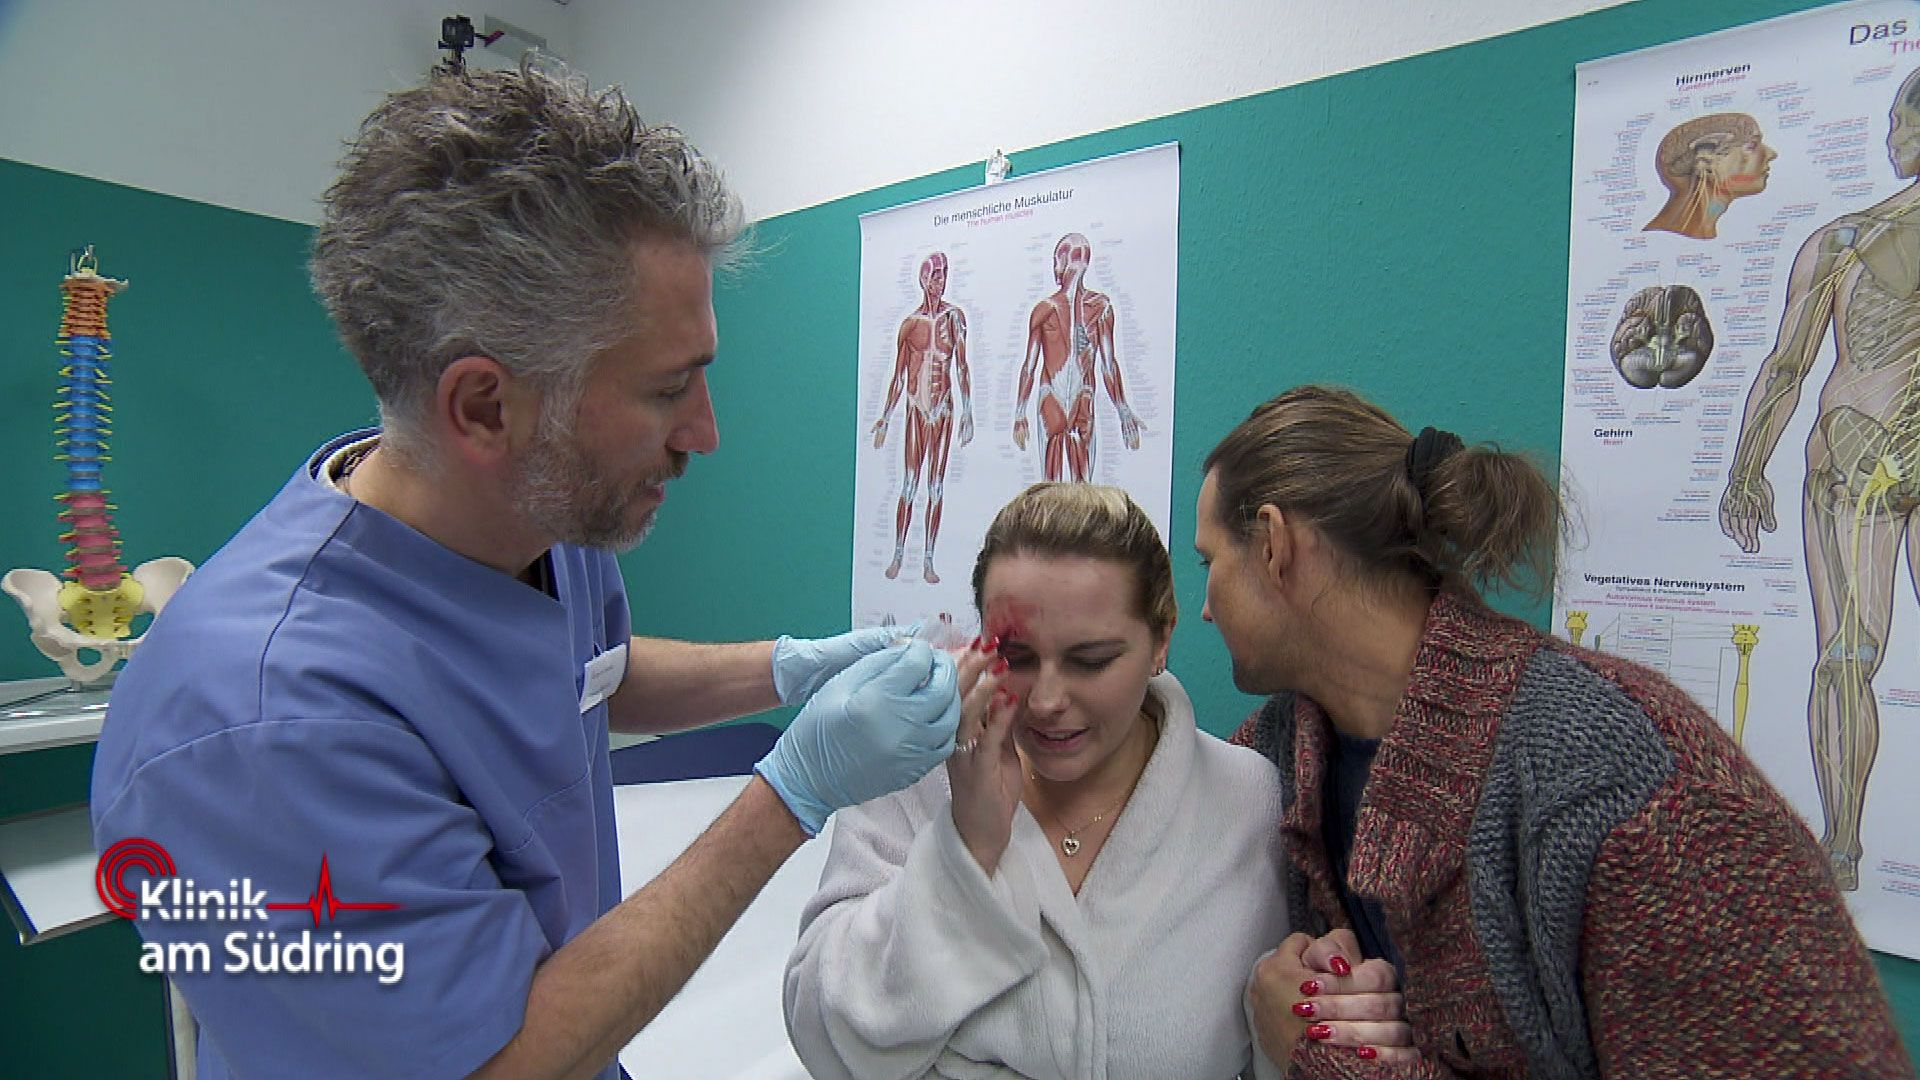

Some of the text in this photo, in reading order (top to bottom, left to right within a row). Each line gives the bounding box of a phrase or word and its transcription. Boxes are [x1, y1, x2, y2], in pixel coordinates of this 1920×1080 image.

[1850, 19, 1907, 45] Das
[1675, 64, 1751, 86] Hirnnerven
[933, 188, 1074, 228] Die menschliche Muskulatur
[1593, 428, 1633, 438] Gehirn
[1584, 573, 1651, 586] Vegetatives
[1654, 577, 1746, 592] Nervensystem
